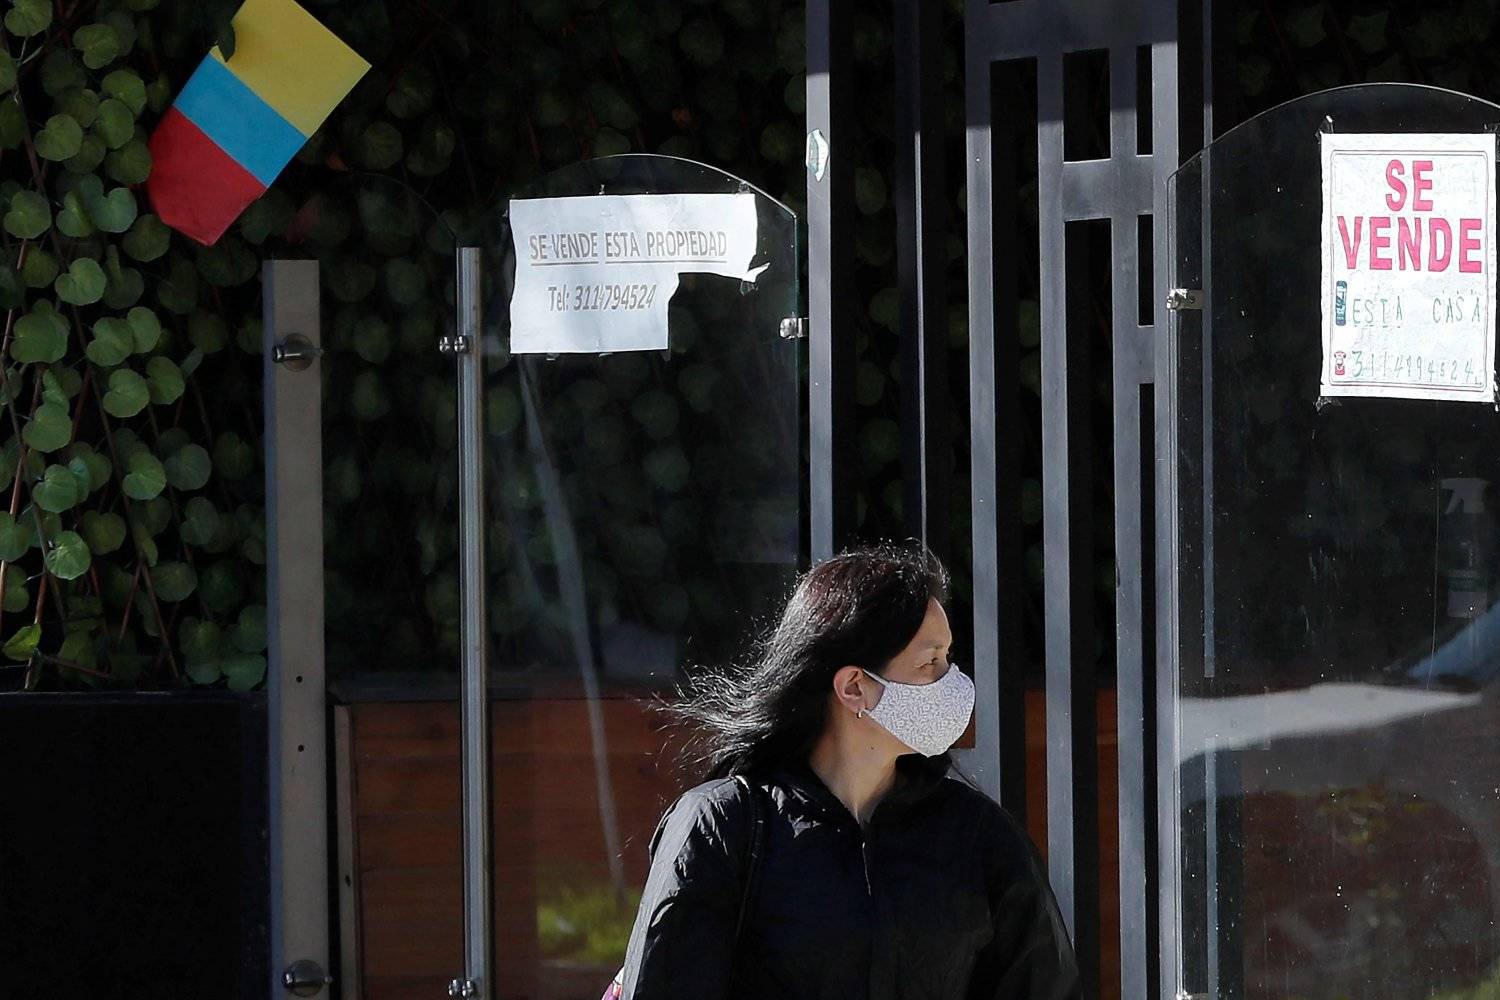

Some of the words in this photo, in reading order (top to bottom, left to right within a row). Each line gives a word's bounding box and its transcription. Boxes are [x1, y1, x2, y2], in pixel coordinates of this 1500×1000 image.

[1385, 158, 1434, 212] SE
[529, 233, 548, 260] SE
[551, 231, 598, 259] VENDE
[604, 231, 641, 258] ESTA
[646, 230, 727, 257] PROPIEDAD
[1336, 215, 1482, 274] VENDE
[547, 283, 570, 312] Tel:
[1352, 295, 1404, 324] ESTA
[1432, 295, 1481, 324] CASA
